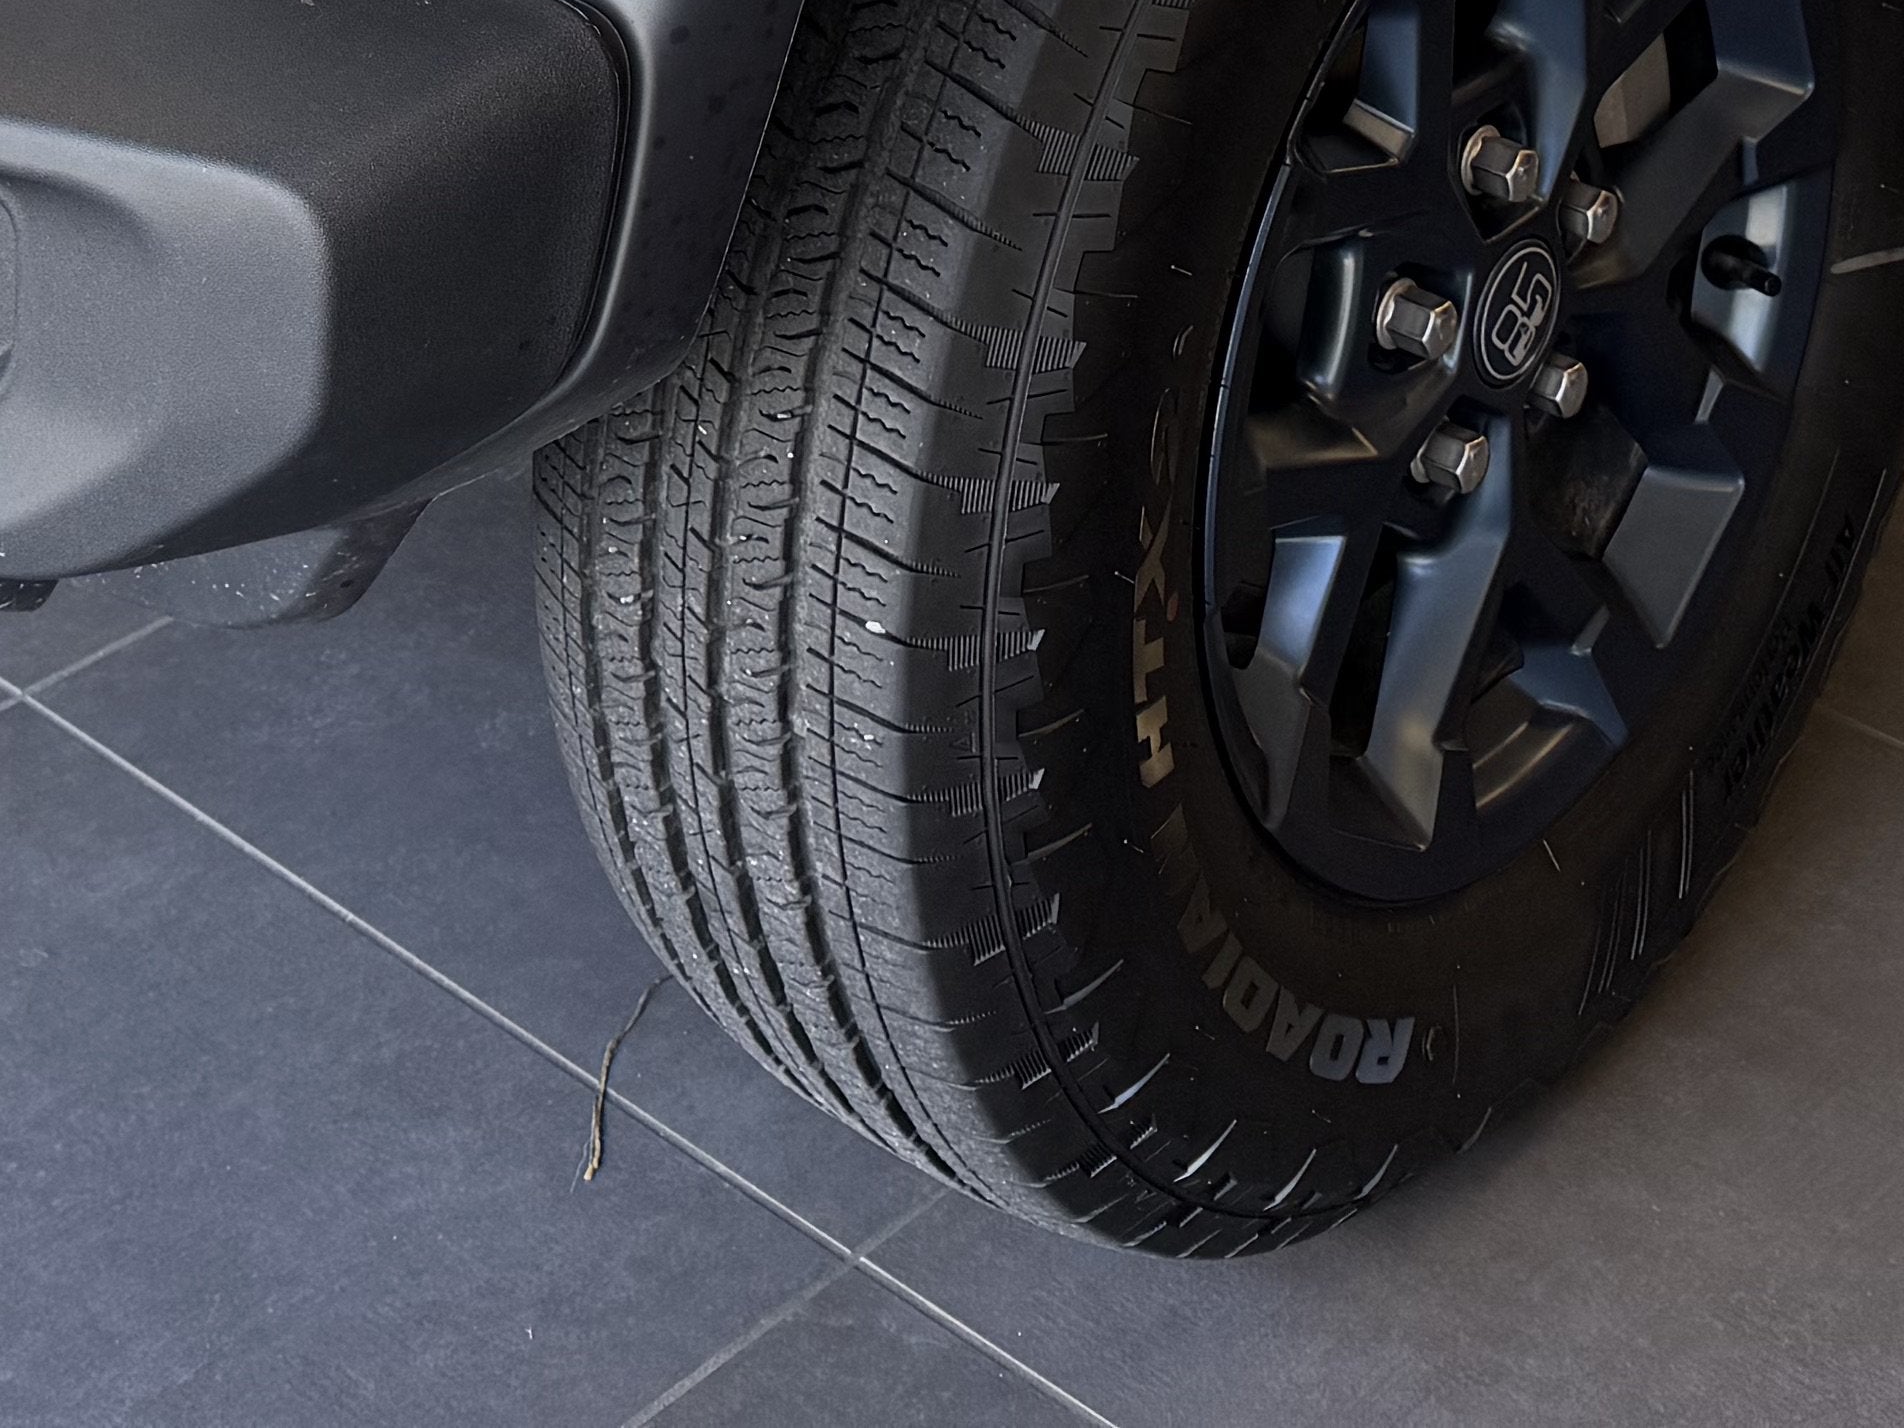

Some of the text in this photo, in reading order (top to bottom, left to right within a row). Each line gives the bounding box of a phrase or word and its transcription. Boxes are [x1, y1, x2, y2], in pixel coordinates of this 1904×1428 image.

[1491, 260, 1553, 367] 85
[1132, 490, 1175, 789] HTX
[1151, 801, 1415, 1085] ROADIAN
